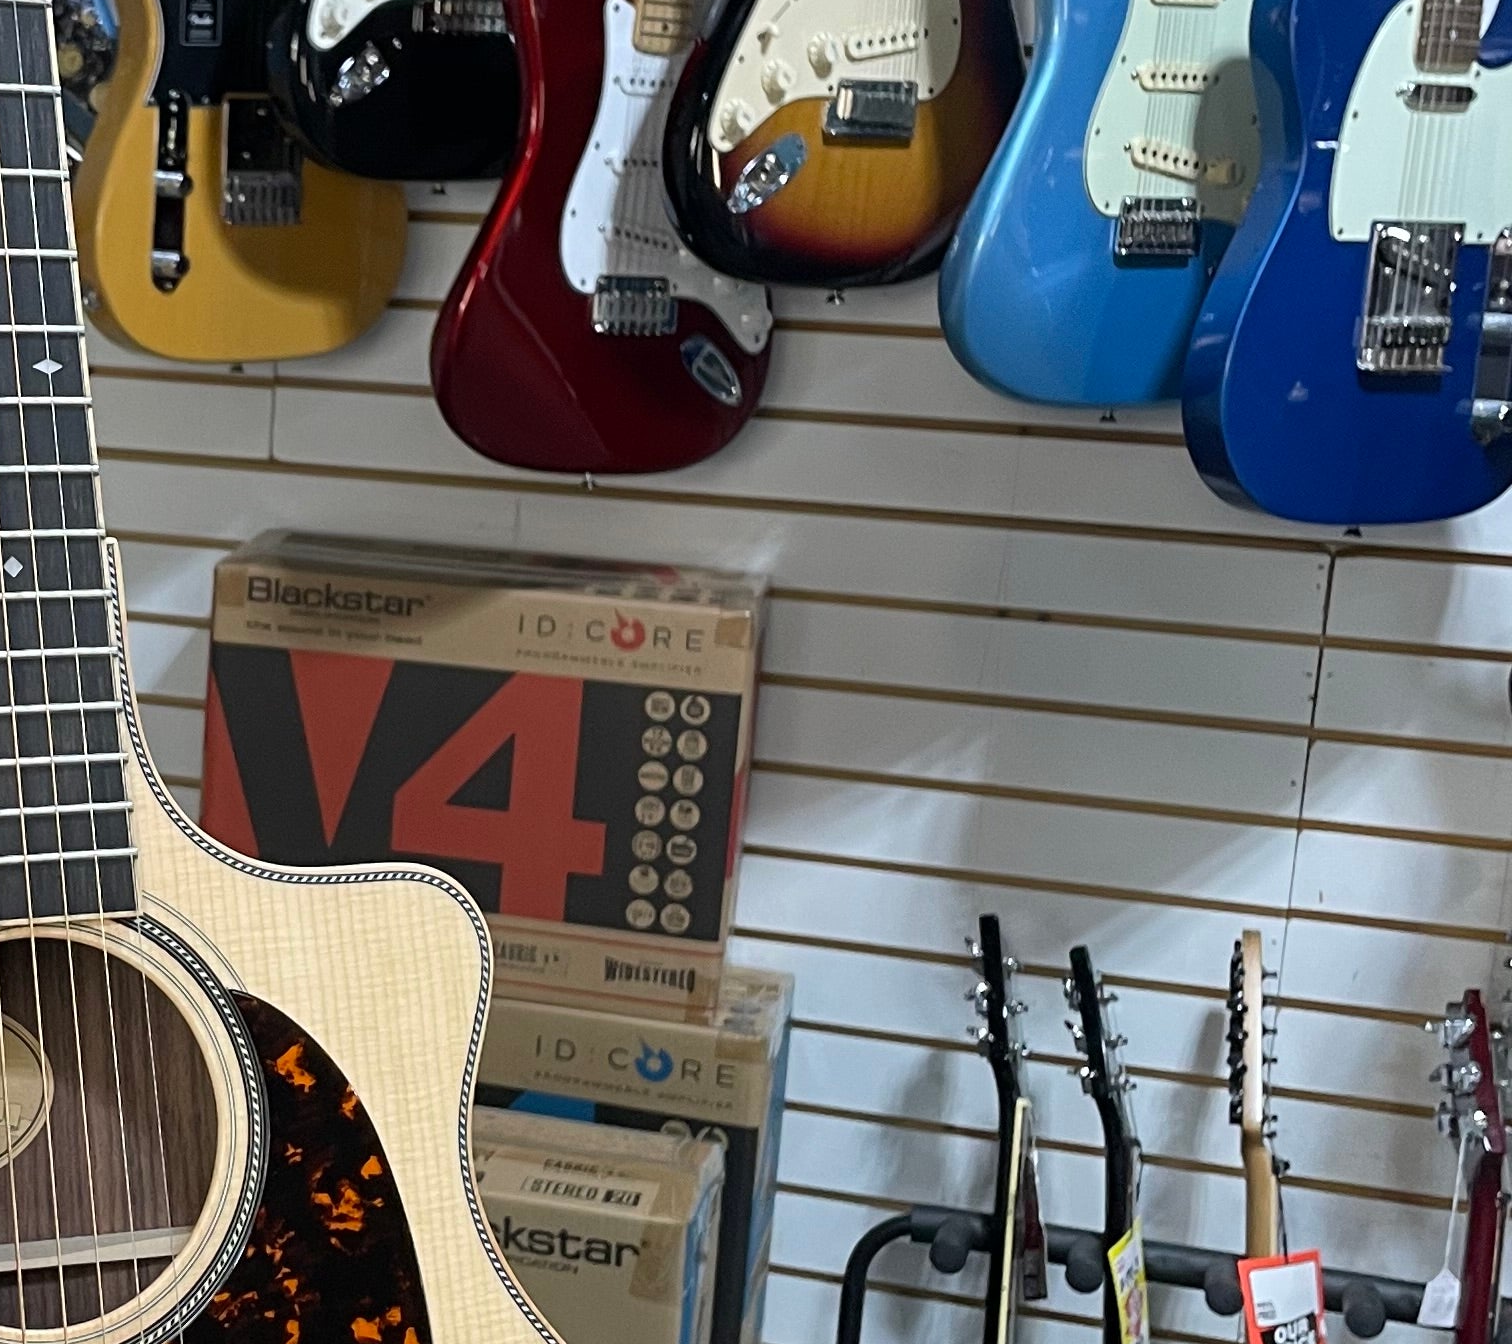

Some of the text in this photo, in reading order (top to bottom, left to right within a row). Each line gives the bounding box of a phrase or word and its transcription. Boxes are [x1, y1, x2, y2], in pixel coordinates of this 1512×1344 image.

[248, 576, 425, 617] Blackstar
[530, 1177, 599, 1200] STEREO
[489, 1216, 640, 1267] ckstar
[1274, 1316, 1309, 1344] OUR
